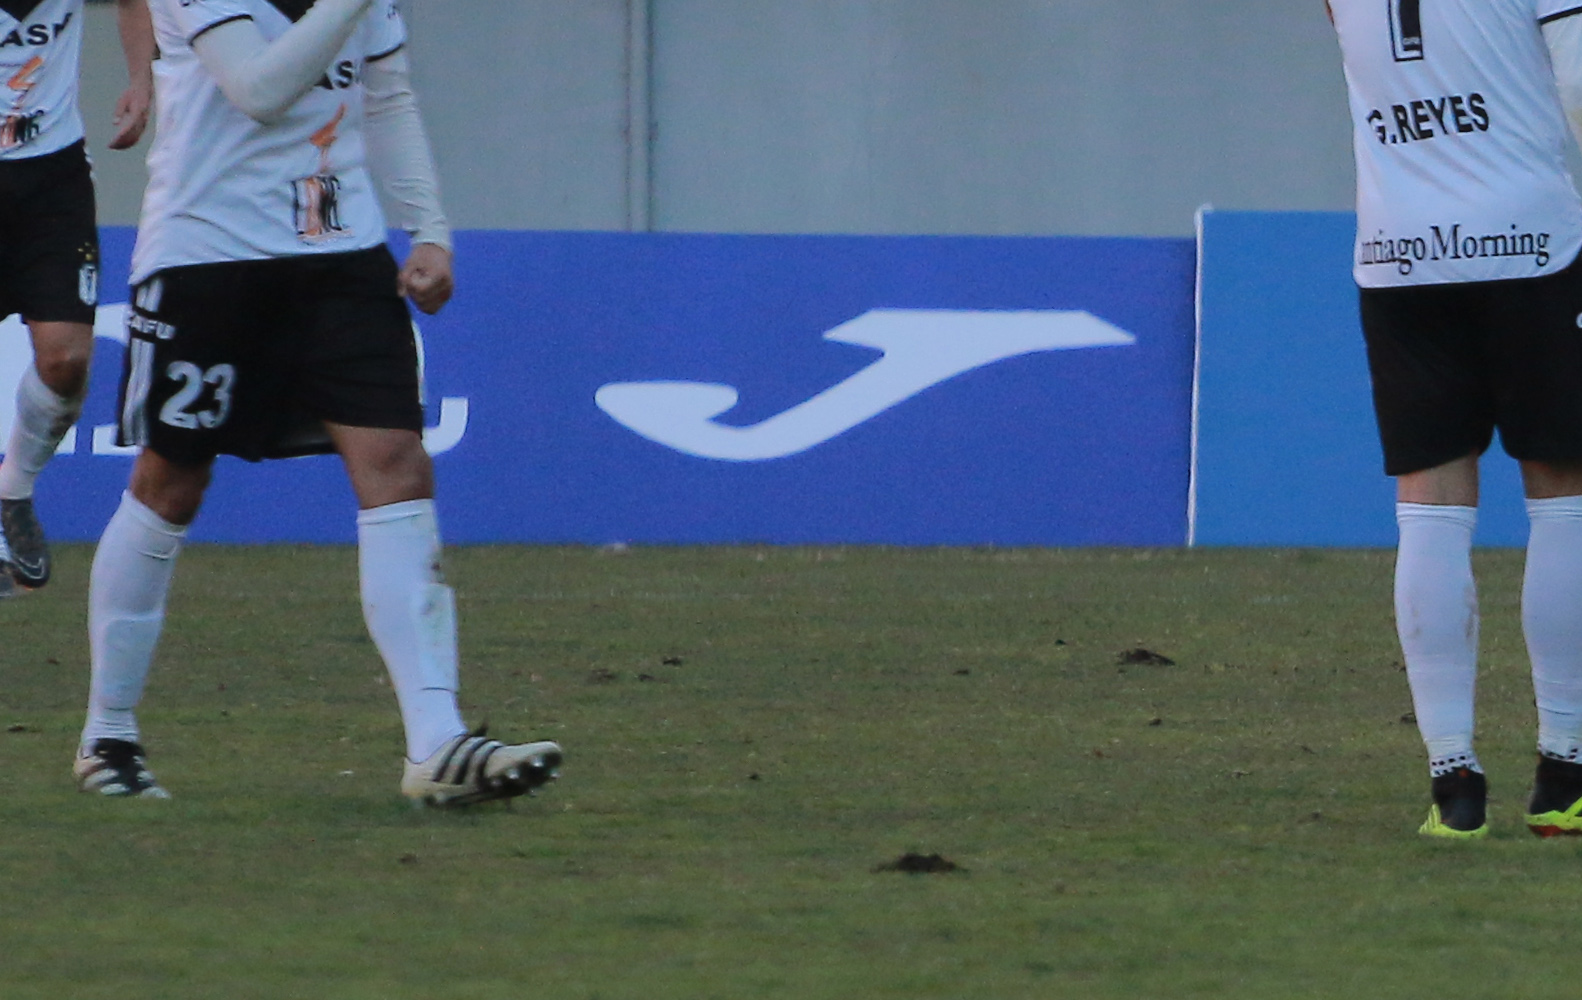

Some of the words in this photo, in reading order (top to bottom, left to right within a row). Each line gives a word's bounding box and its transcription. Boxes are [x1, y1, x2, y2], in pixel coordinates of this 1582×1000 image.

[1366, 92, 1490, 145] G.REYES
[1429, 224, 1550, 267] Morning
[159, 359, 236, 430] 23
